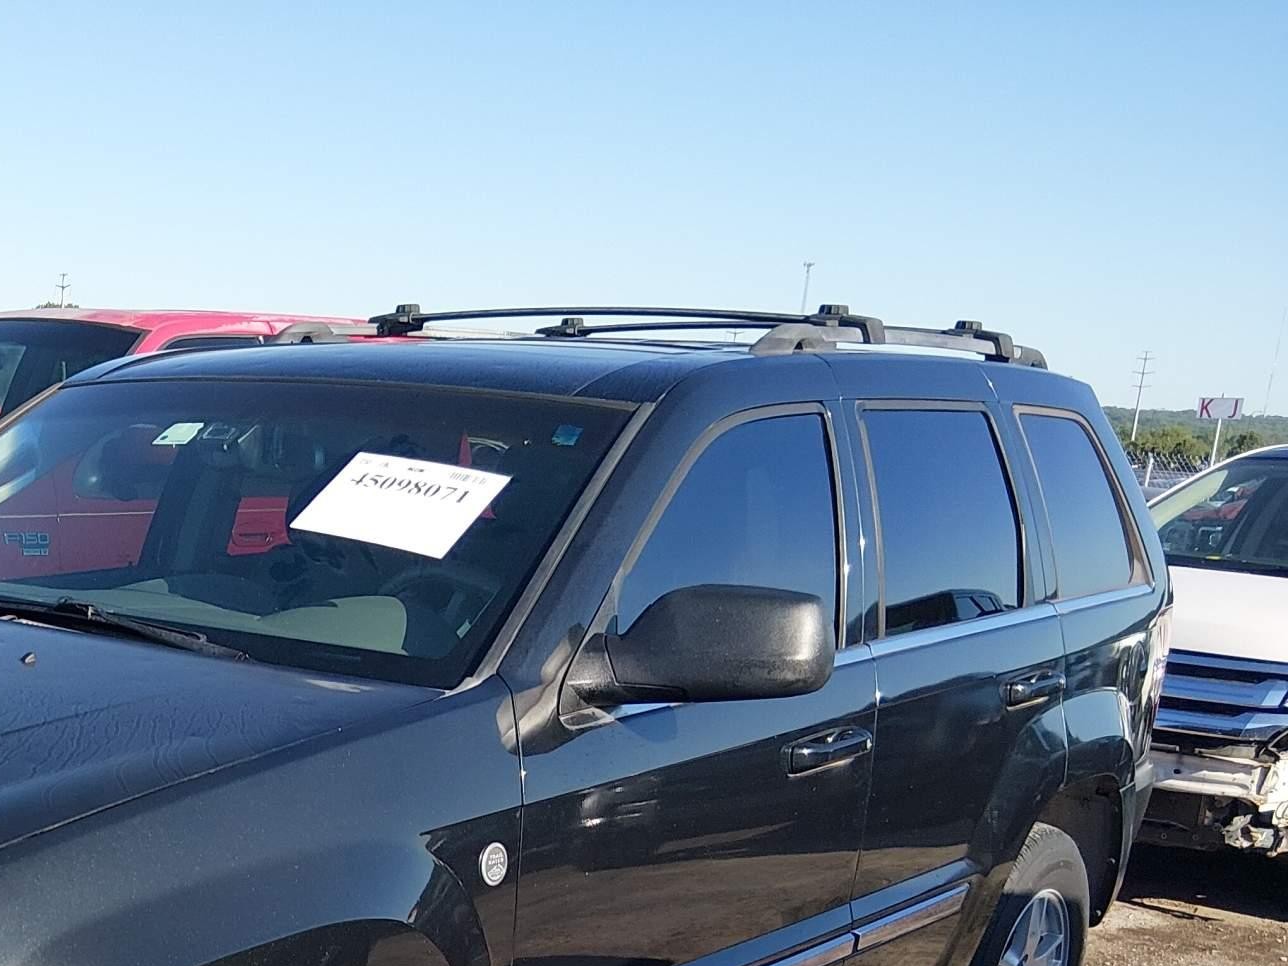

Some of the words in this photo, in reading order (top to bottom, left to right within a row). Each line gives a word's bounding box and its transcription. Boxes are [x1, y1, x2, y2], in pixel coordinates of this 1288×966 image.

[1199, 399, 1214, 418] K
[1228, 399, 1239, 418] J
[351, 472, 470, 503] 45098071
